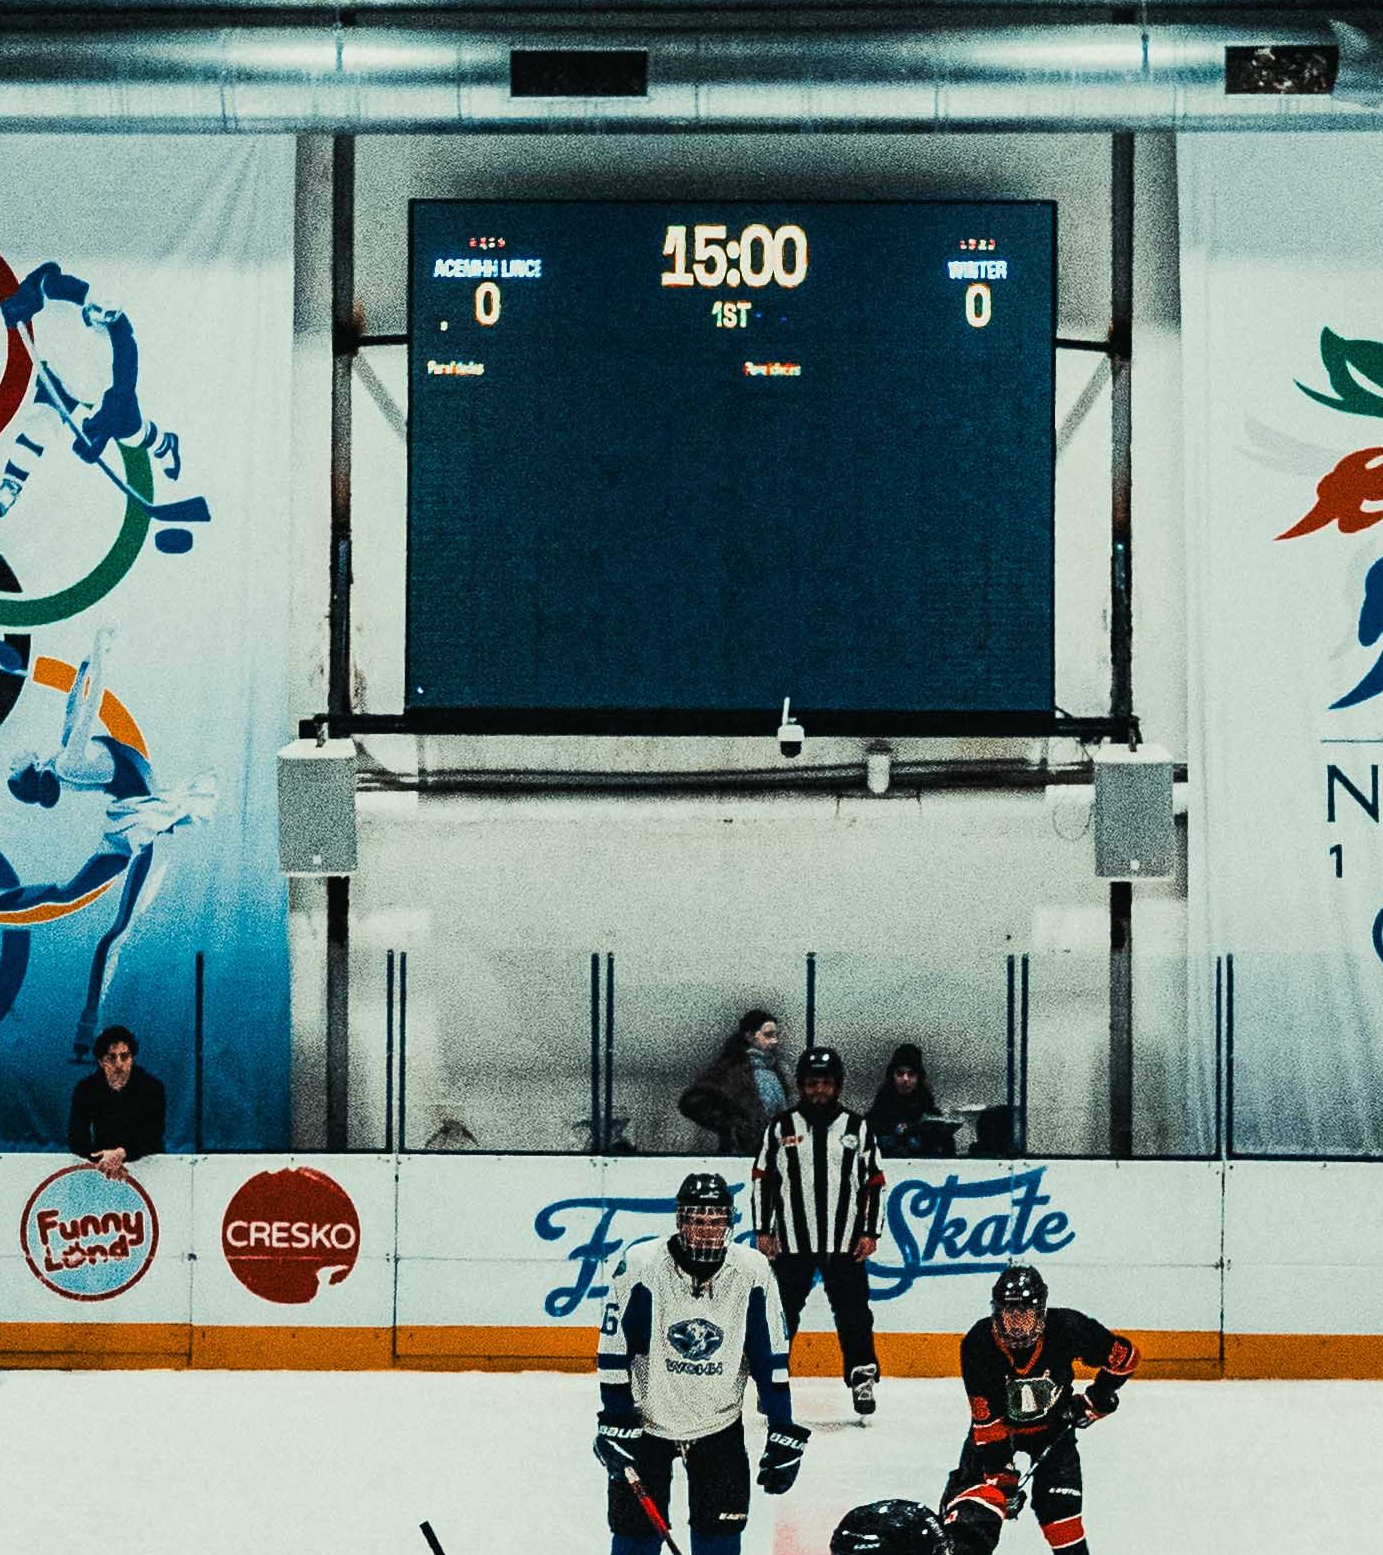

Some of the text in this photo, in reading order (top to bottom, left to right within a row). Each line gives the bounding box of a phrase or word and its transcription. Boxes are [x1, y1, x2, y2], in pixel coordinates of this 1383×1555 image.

[661, 223, 808, 289] 15:00
[474, 281, 501, 326] 0
[711, 300, 752, 328] 1ST
[965, 282, 992, 328] 0
[36, 1209, 146, 1249] Funny
[226, 1220, 357, 1250] CRESKO
[868, 1165, 1076, 1302] Skate
